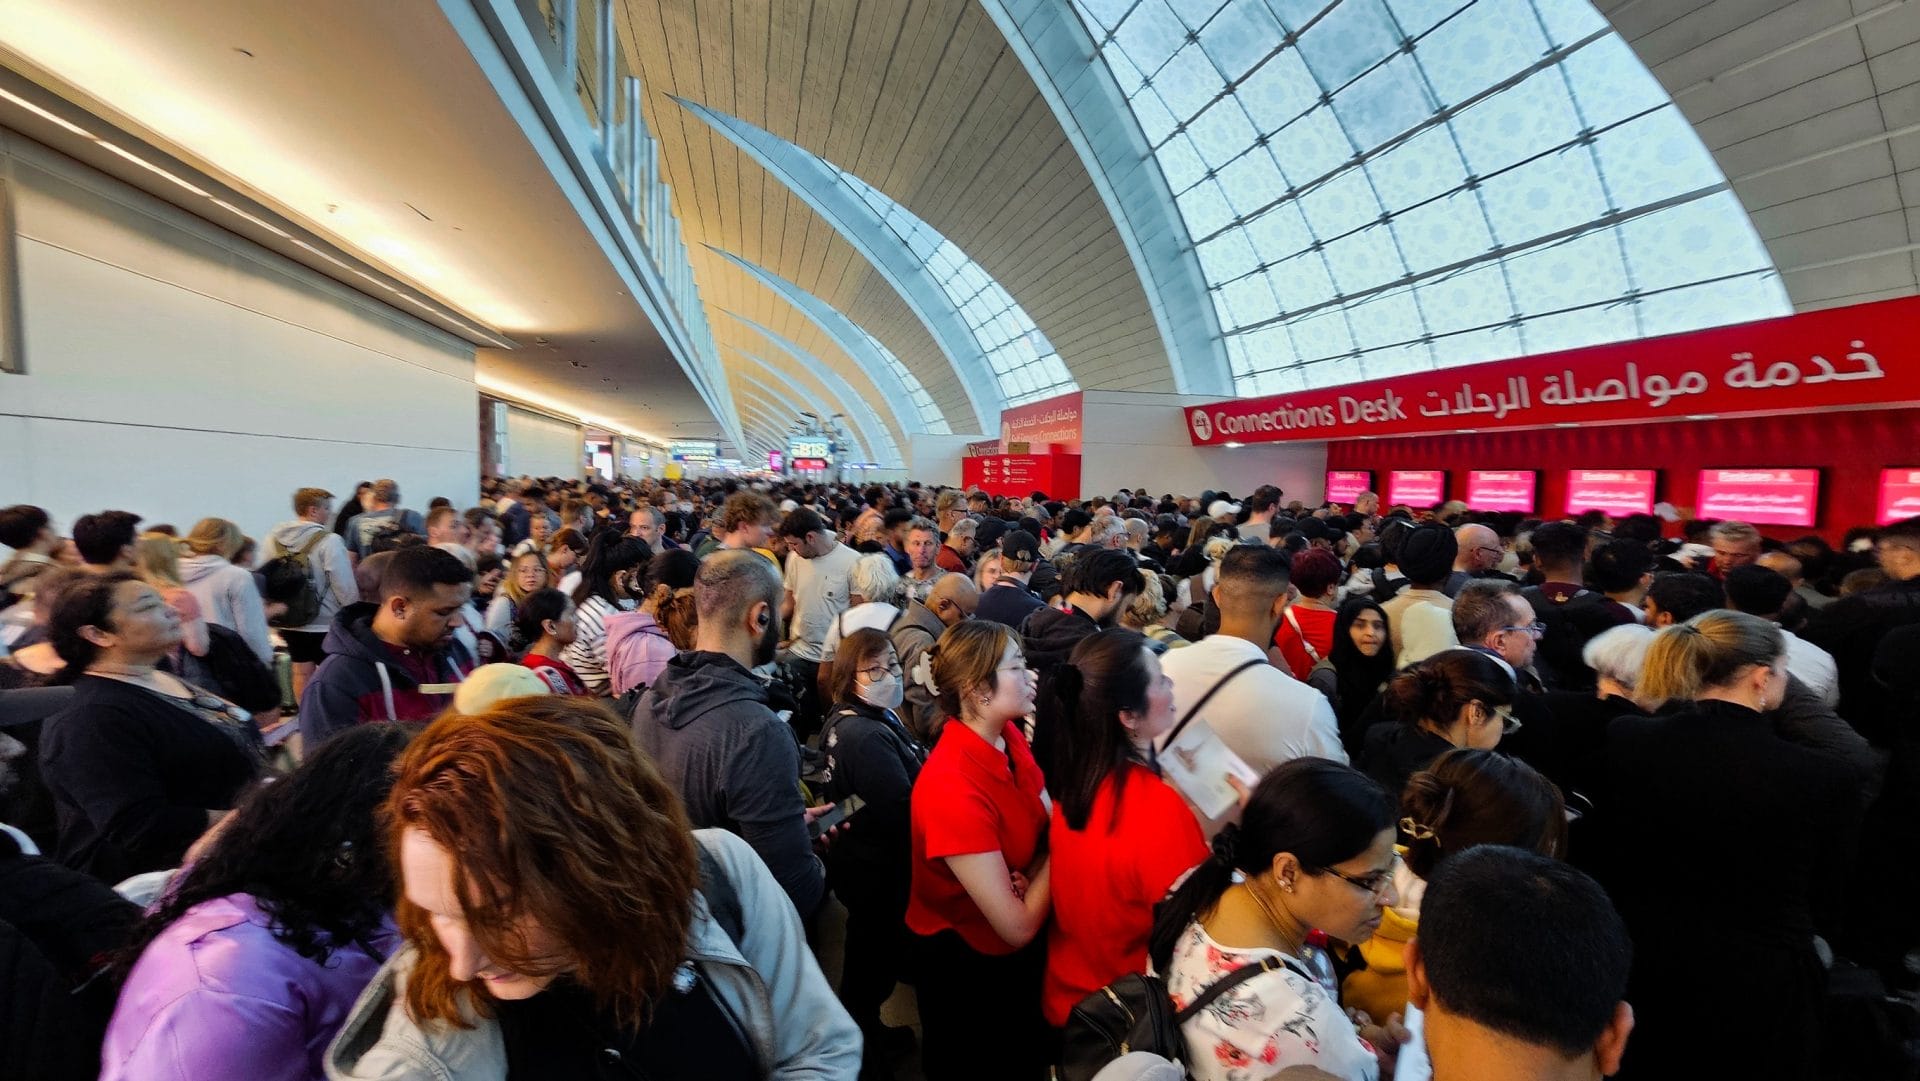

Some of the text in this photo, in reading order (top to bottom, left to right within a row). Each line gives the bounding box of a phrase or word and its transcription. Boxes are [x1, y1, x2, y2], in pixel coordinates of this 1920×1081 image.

[1419, 339, 1886, 420] خدمة مواصلة الرحلات
[1039, 426, 1077, 442] Connections
[1215, 388, 1408, 436] Connections Desk
